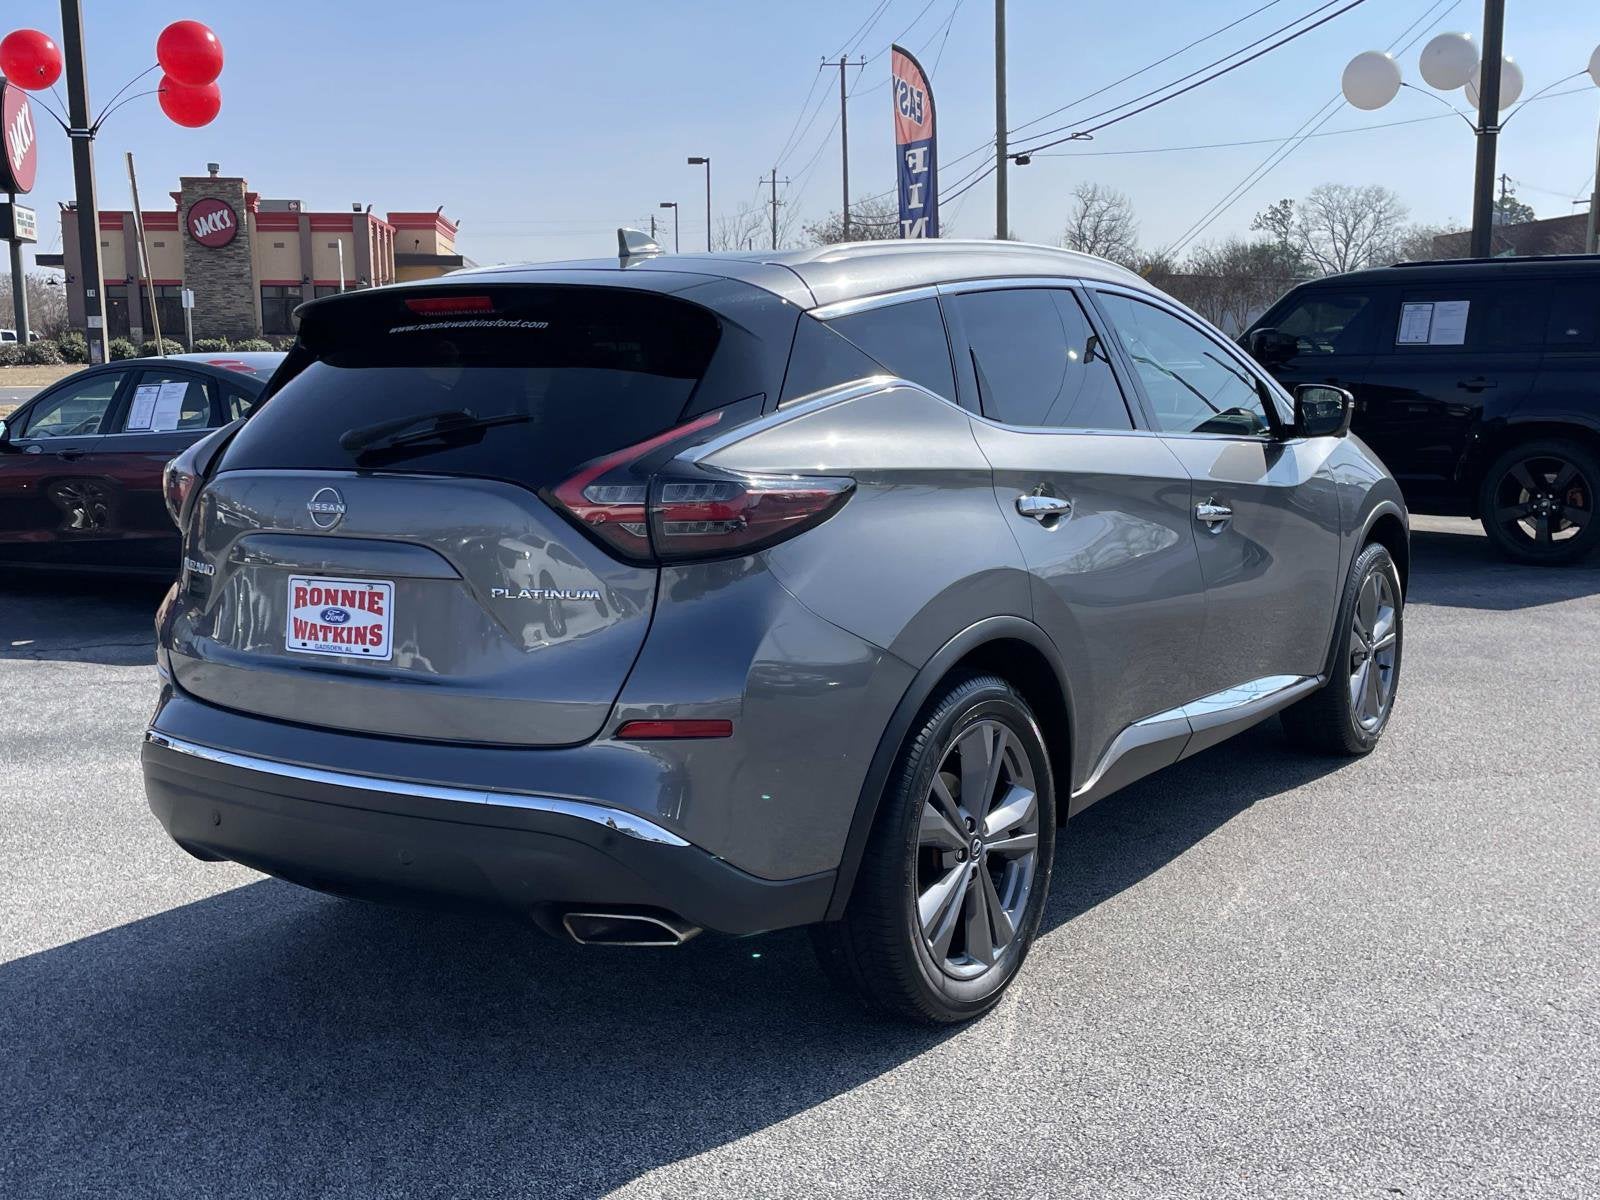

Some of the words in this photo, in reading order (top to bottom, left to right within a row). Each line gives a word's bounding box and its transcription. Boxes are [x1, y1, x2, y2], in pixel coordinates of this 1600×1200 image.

[193, 209, 232, 238] JACK'S
[389, 318, 550, 334] www.ronniewatkinsford.com
[307, 502, 345, 514] NISSAN
[294, 586, 385, 617] RONNIE
[491, 587, 601, 601] PLATINUM
[323, 609, 346, 623] Ford
[293, 616, 383, 647] WATKINS
